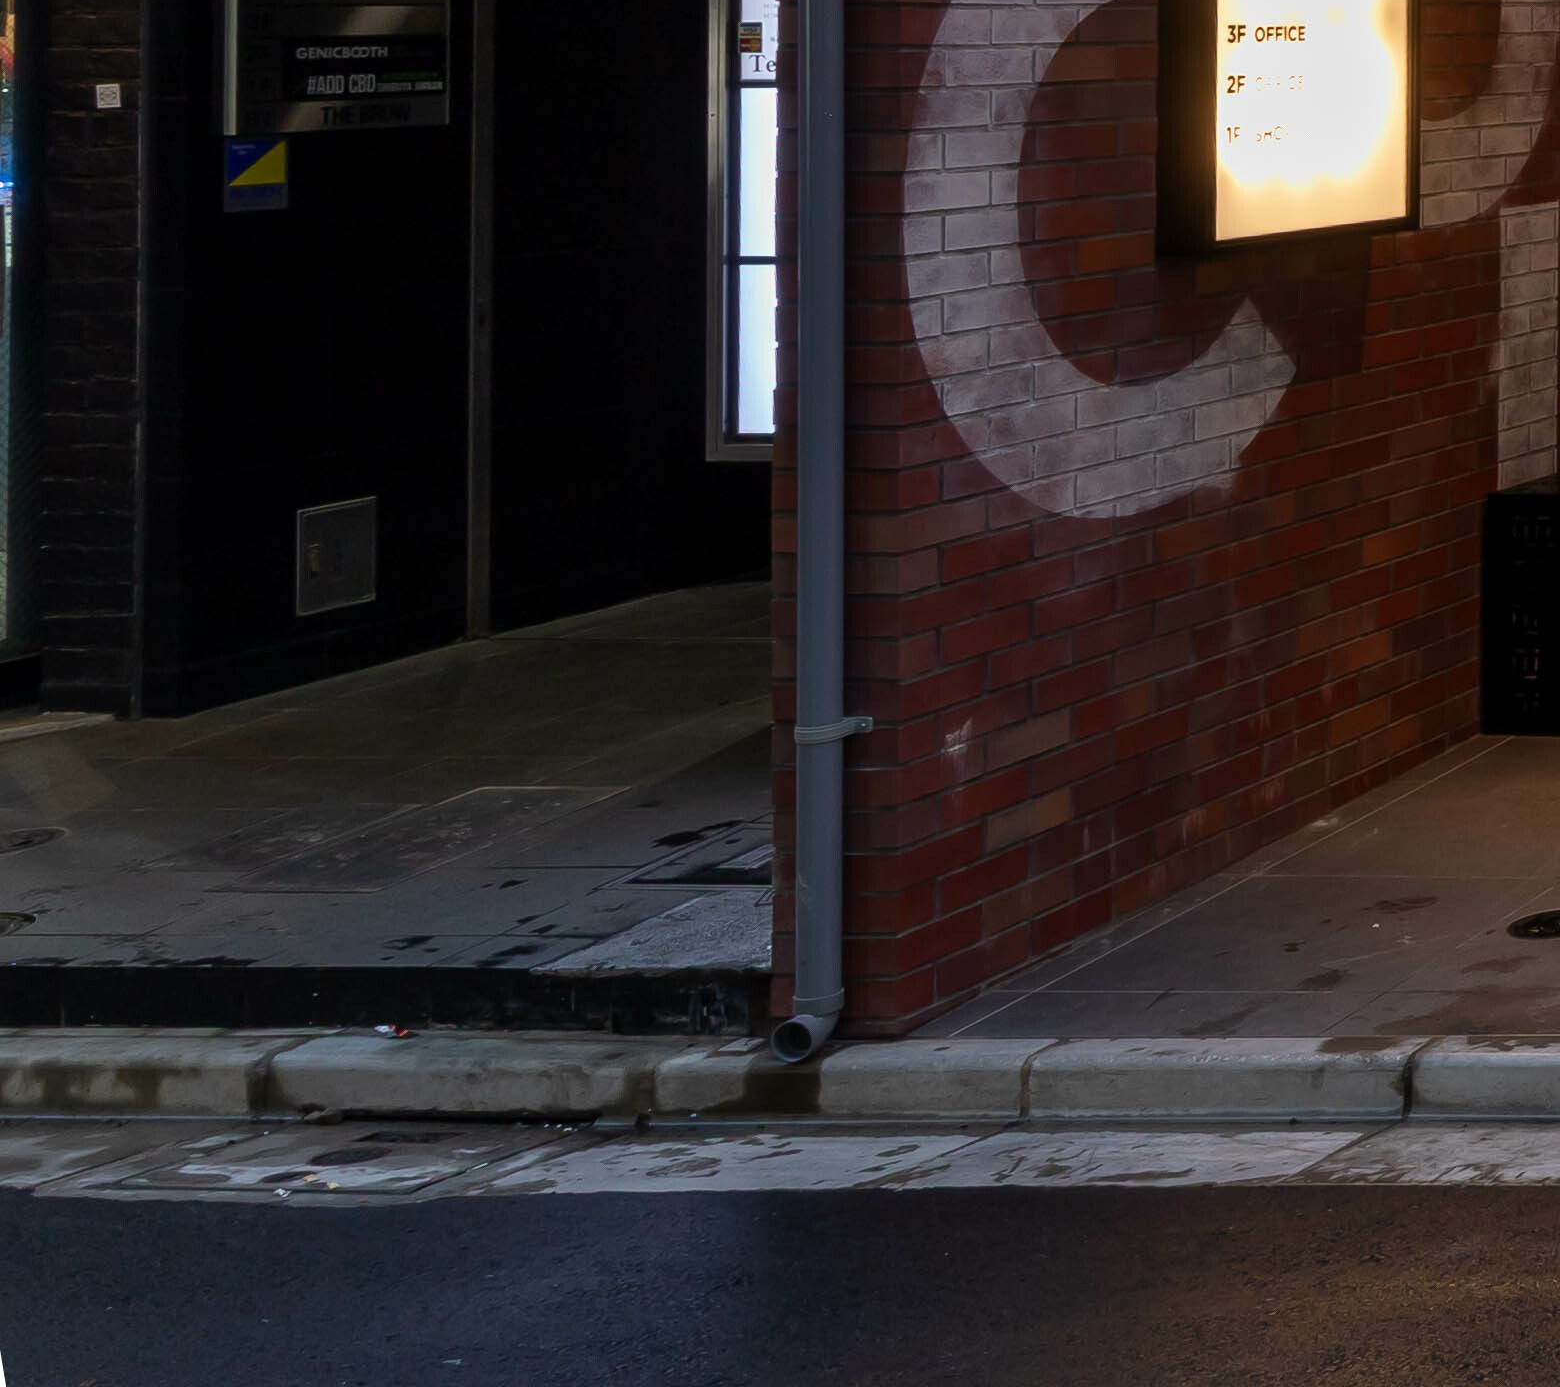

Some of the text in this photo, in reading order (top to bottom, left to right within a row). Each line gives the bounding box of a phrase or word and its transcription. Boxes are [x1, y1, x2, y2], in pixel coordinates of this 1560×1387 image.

[1226, 24, 1307, 44] 3F OFFICE
[295, 45, 389, 60] GENICBOOTH
[1225, 74, 1247, 95] 2F
